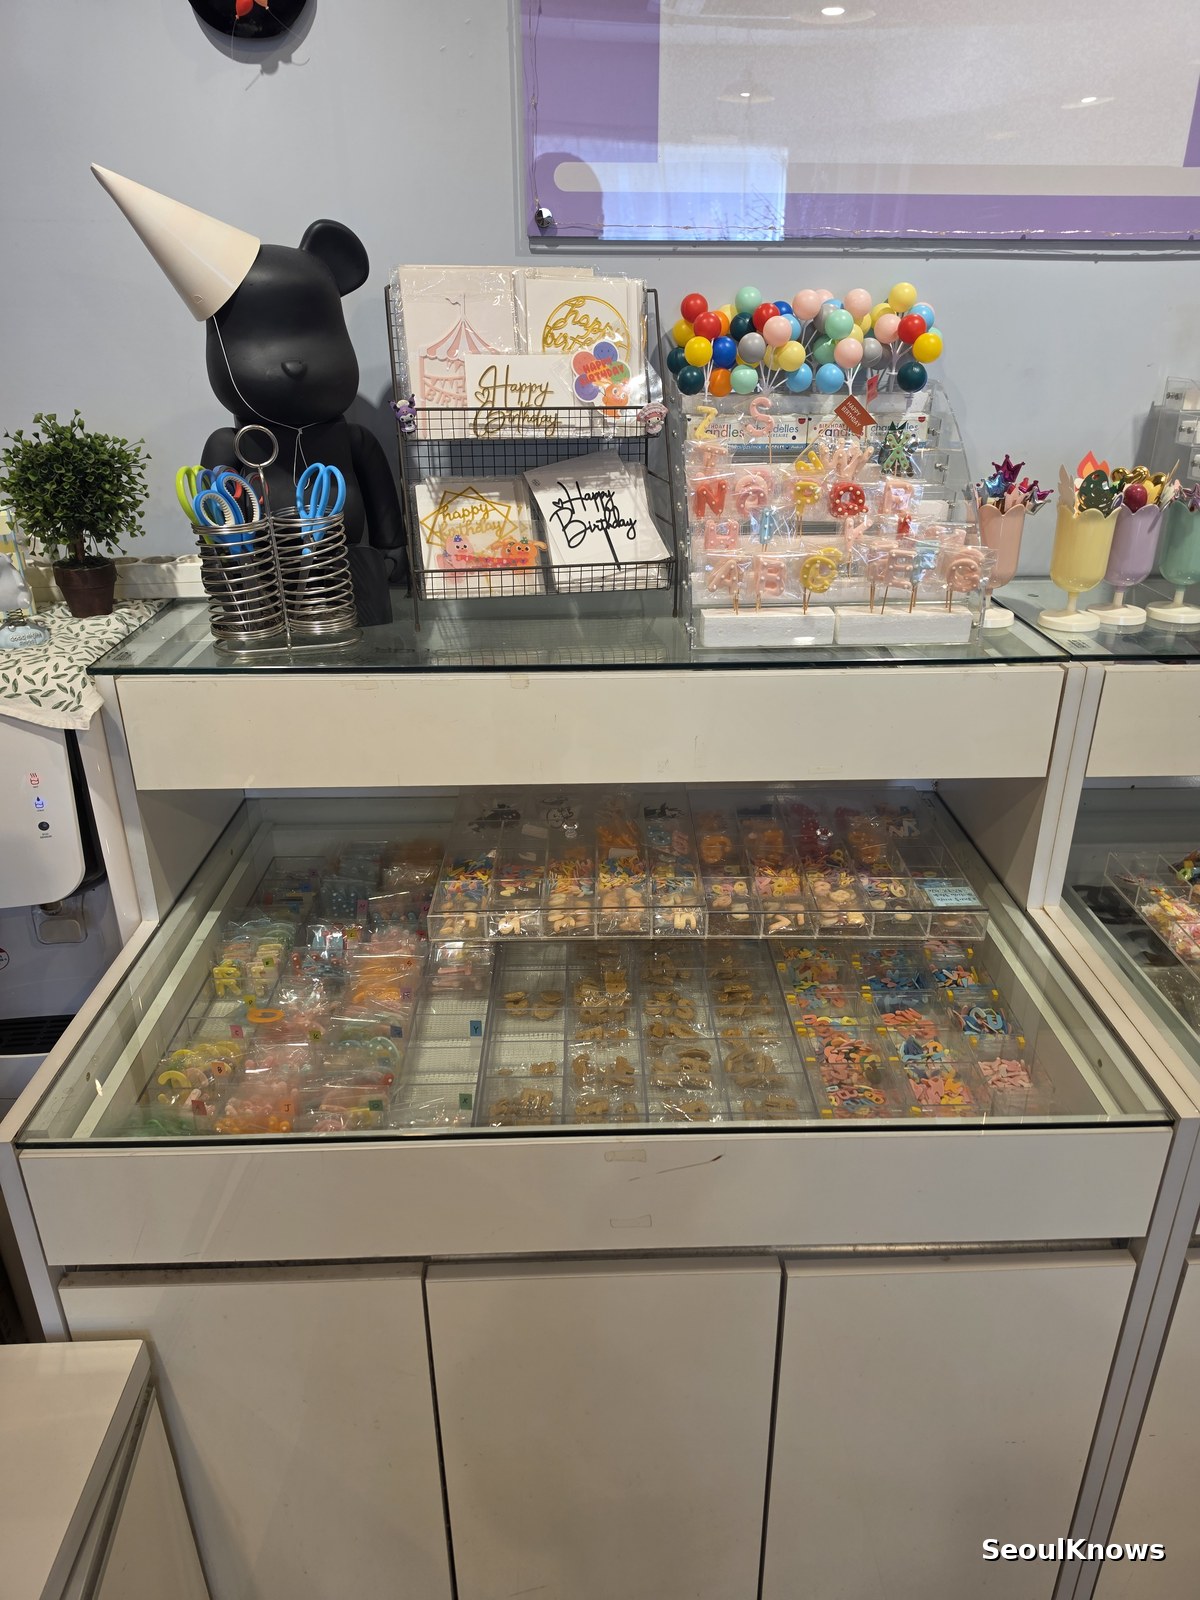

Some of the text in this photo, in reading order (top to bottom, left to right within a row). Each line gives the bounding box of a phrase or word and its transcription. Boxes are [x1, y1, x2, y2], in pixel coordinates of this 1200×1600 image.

[580, 364, 625, 388] BIRTHDAY
[583, 357, 613, 374] HAPPY
[478, 364, 554, 408] Happy
[745, 397, 775, 437] S
[841, 406, 861, 427] BIRTHDAY
[847, 401, 861, 416] HAPPY
[884, 433, 911, 470] X
[440, 504, 496, 522] happy
[556, 481, 615, 515] Happy
[693, 478, 727, 517] N
[549, 506, 637, 549] Birthday
